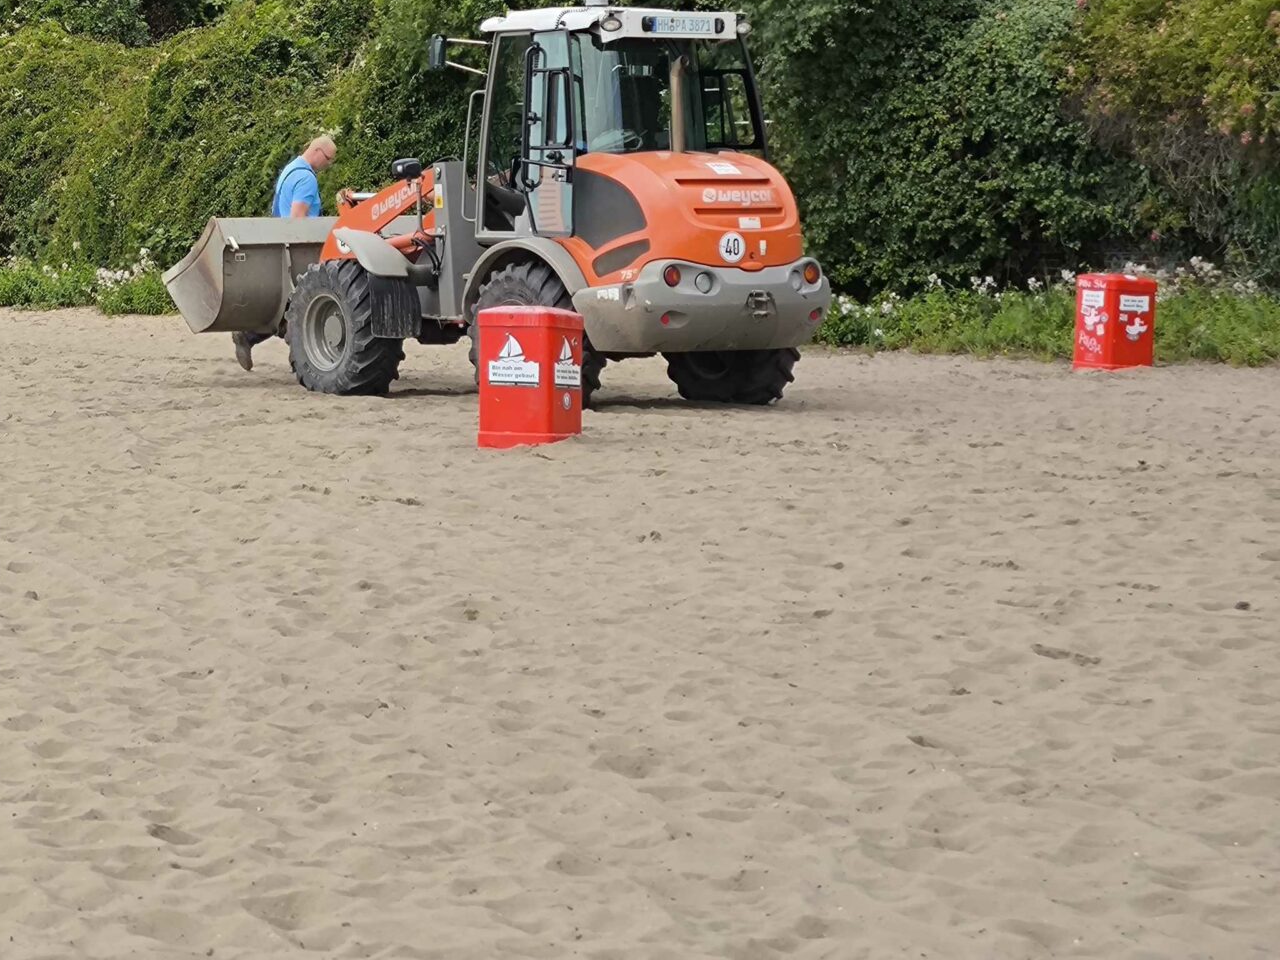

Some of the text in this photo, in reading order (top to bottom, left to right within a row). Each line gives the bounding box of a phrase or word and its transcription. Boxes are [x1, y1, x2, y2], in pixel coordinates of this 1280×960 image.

[657, 19, 711, 32] HH PA 3871
[725, 238, 740, 256] 40
